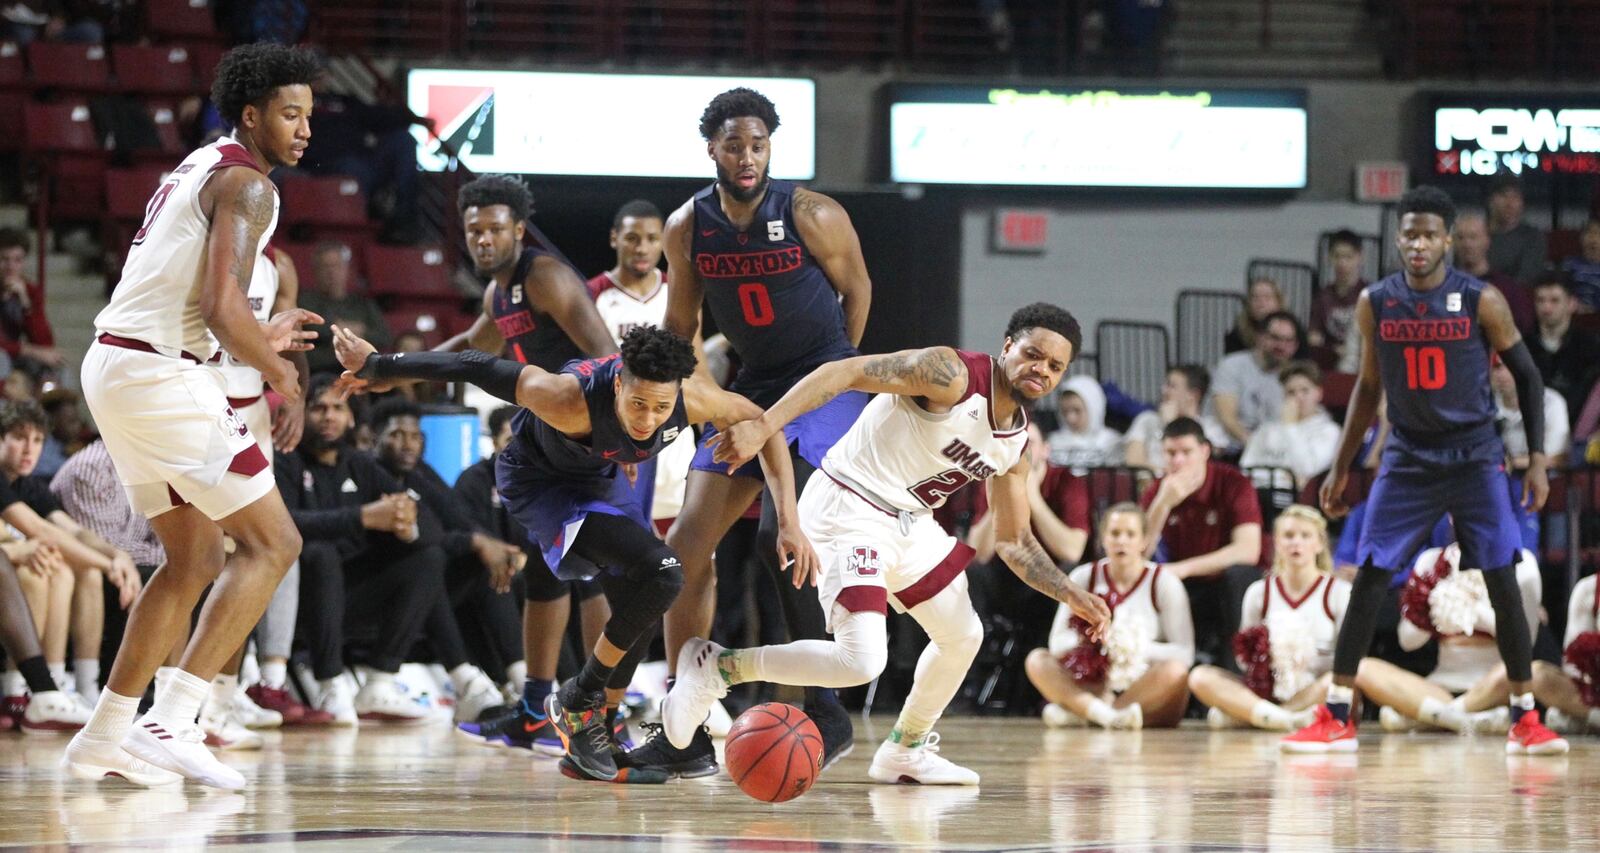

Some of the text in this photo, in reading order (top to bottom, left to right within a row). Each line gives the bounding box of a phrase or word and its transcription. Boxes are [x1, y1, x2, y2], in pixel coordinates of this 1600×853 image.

[767, 220, 785, 241] 5
[696, 246, 801, 277] DAYTON
[511, 283, 523, 304] 5
[738, 282, 775, 326] 0
[1380, 317, 1470, 341] DAYTON
[1403, 346, 1447, 390] 10
[907, 468, 973, 509] 2
